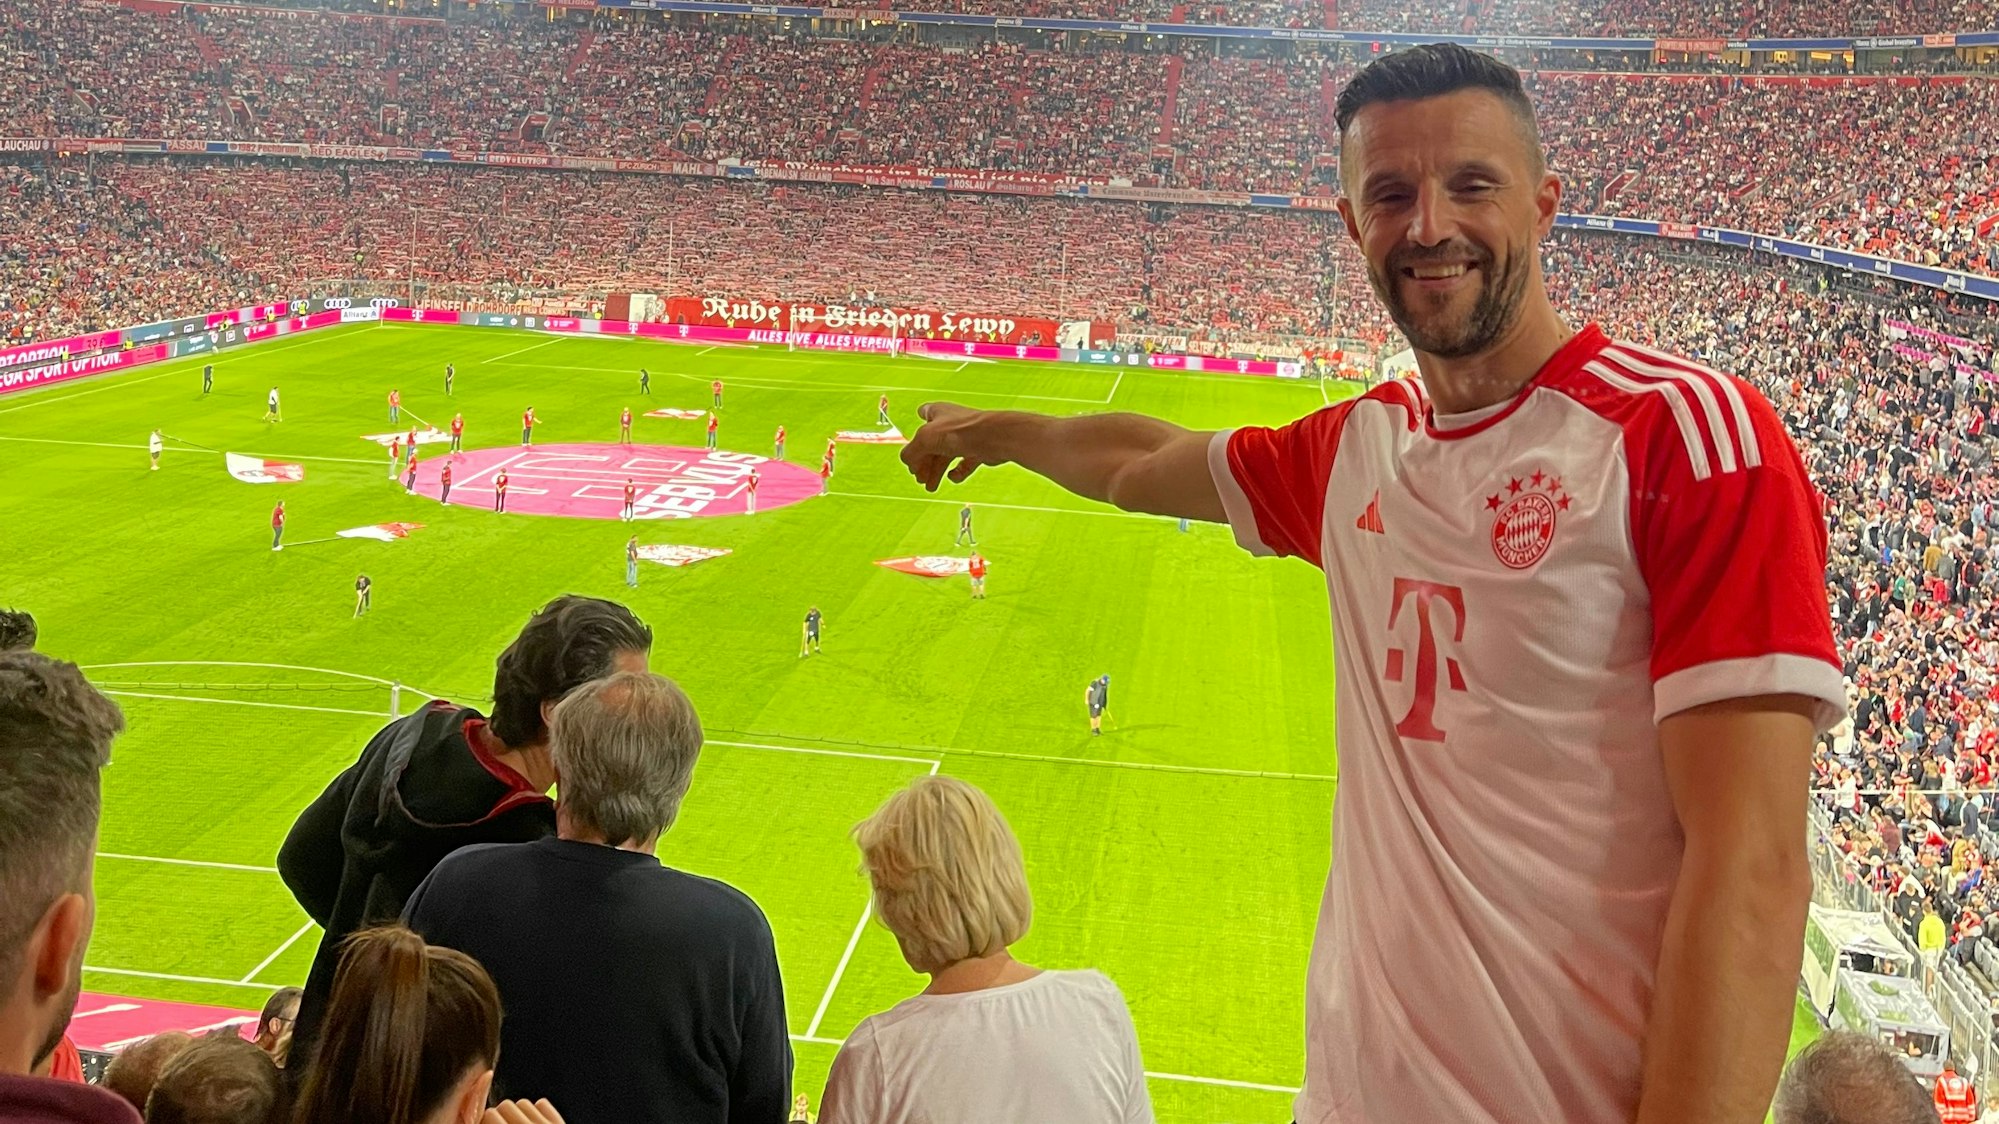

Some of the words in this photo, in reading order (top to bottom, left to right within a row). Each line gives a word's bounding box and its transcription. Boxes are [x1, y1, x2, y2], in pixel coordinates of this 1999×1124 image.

[167, 140, 206, 151] PASSAU
[311, 147, 332, 156] RED
[335, 148, 376, 158] EAGLES
[954, 179, 986, 190] ROSLAU
[1586, 218, 1606, 227] Allianz
[343, 310, 368, 319] Allianz
[703, 297, 782, 324] Ruhe
[790, 304, 815, 323] in
[825, 305, 931, 330] Frieden
[748, 330, 783, 343] ALLES
[816, 335, 850, 347] ALLES
[1517, 497, 1551, 524] BAYERN
[1384, 577, 1467, 743] T
